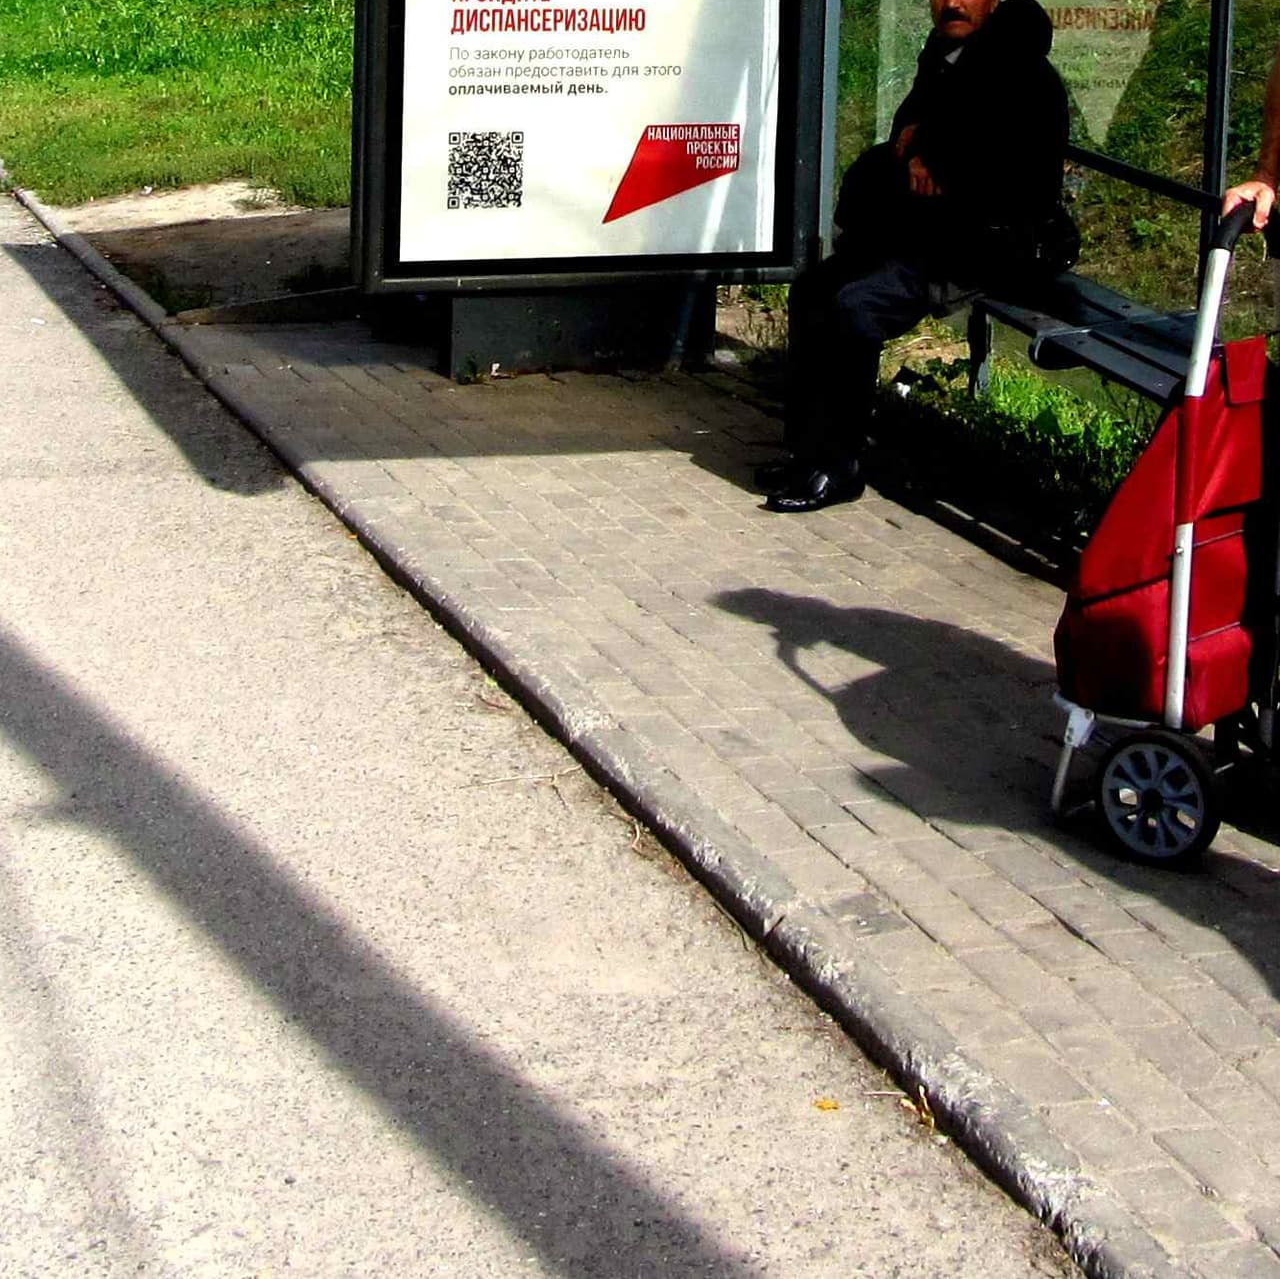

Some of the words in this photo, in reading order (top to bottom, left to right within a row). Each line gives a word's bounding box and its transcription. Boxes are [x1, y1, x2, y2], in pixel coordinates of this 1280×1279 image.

[450, 8, 647, 35] ДИСПАНСЕРИЗАЦИЮ
[449, 47, 470, 60] По
[474, 49, 524, 62] закону
[529, 46, 630, 62] работодатель
[449, 64, 501, 78] обязан
[505, 66, 608, 79] предоставить
[611, 66, 638, 78] для
[643, 65, 682, 76] этого
[448, 81, 564, 96] оплачиваемый
[567, 82, 608, 97] день.
[647, 126, 739, 142] НАЦИОНАЛЬНЫЕ
[686, 141, 738, 155] ПРОЕКТЫ
[695, 155, 738, 169] РОССИИ
